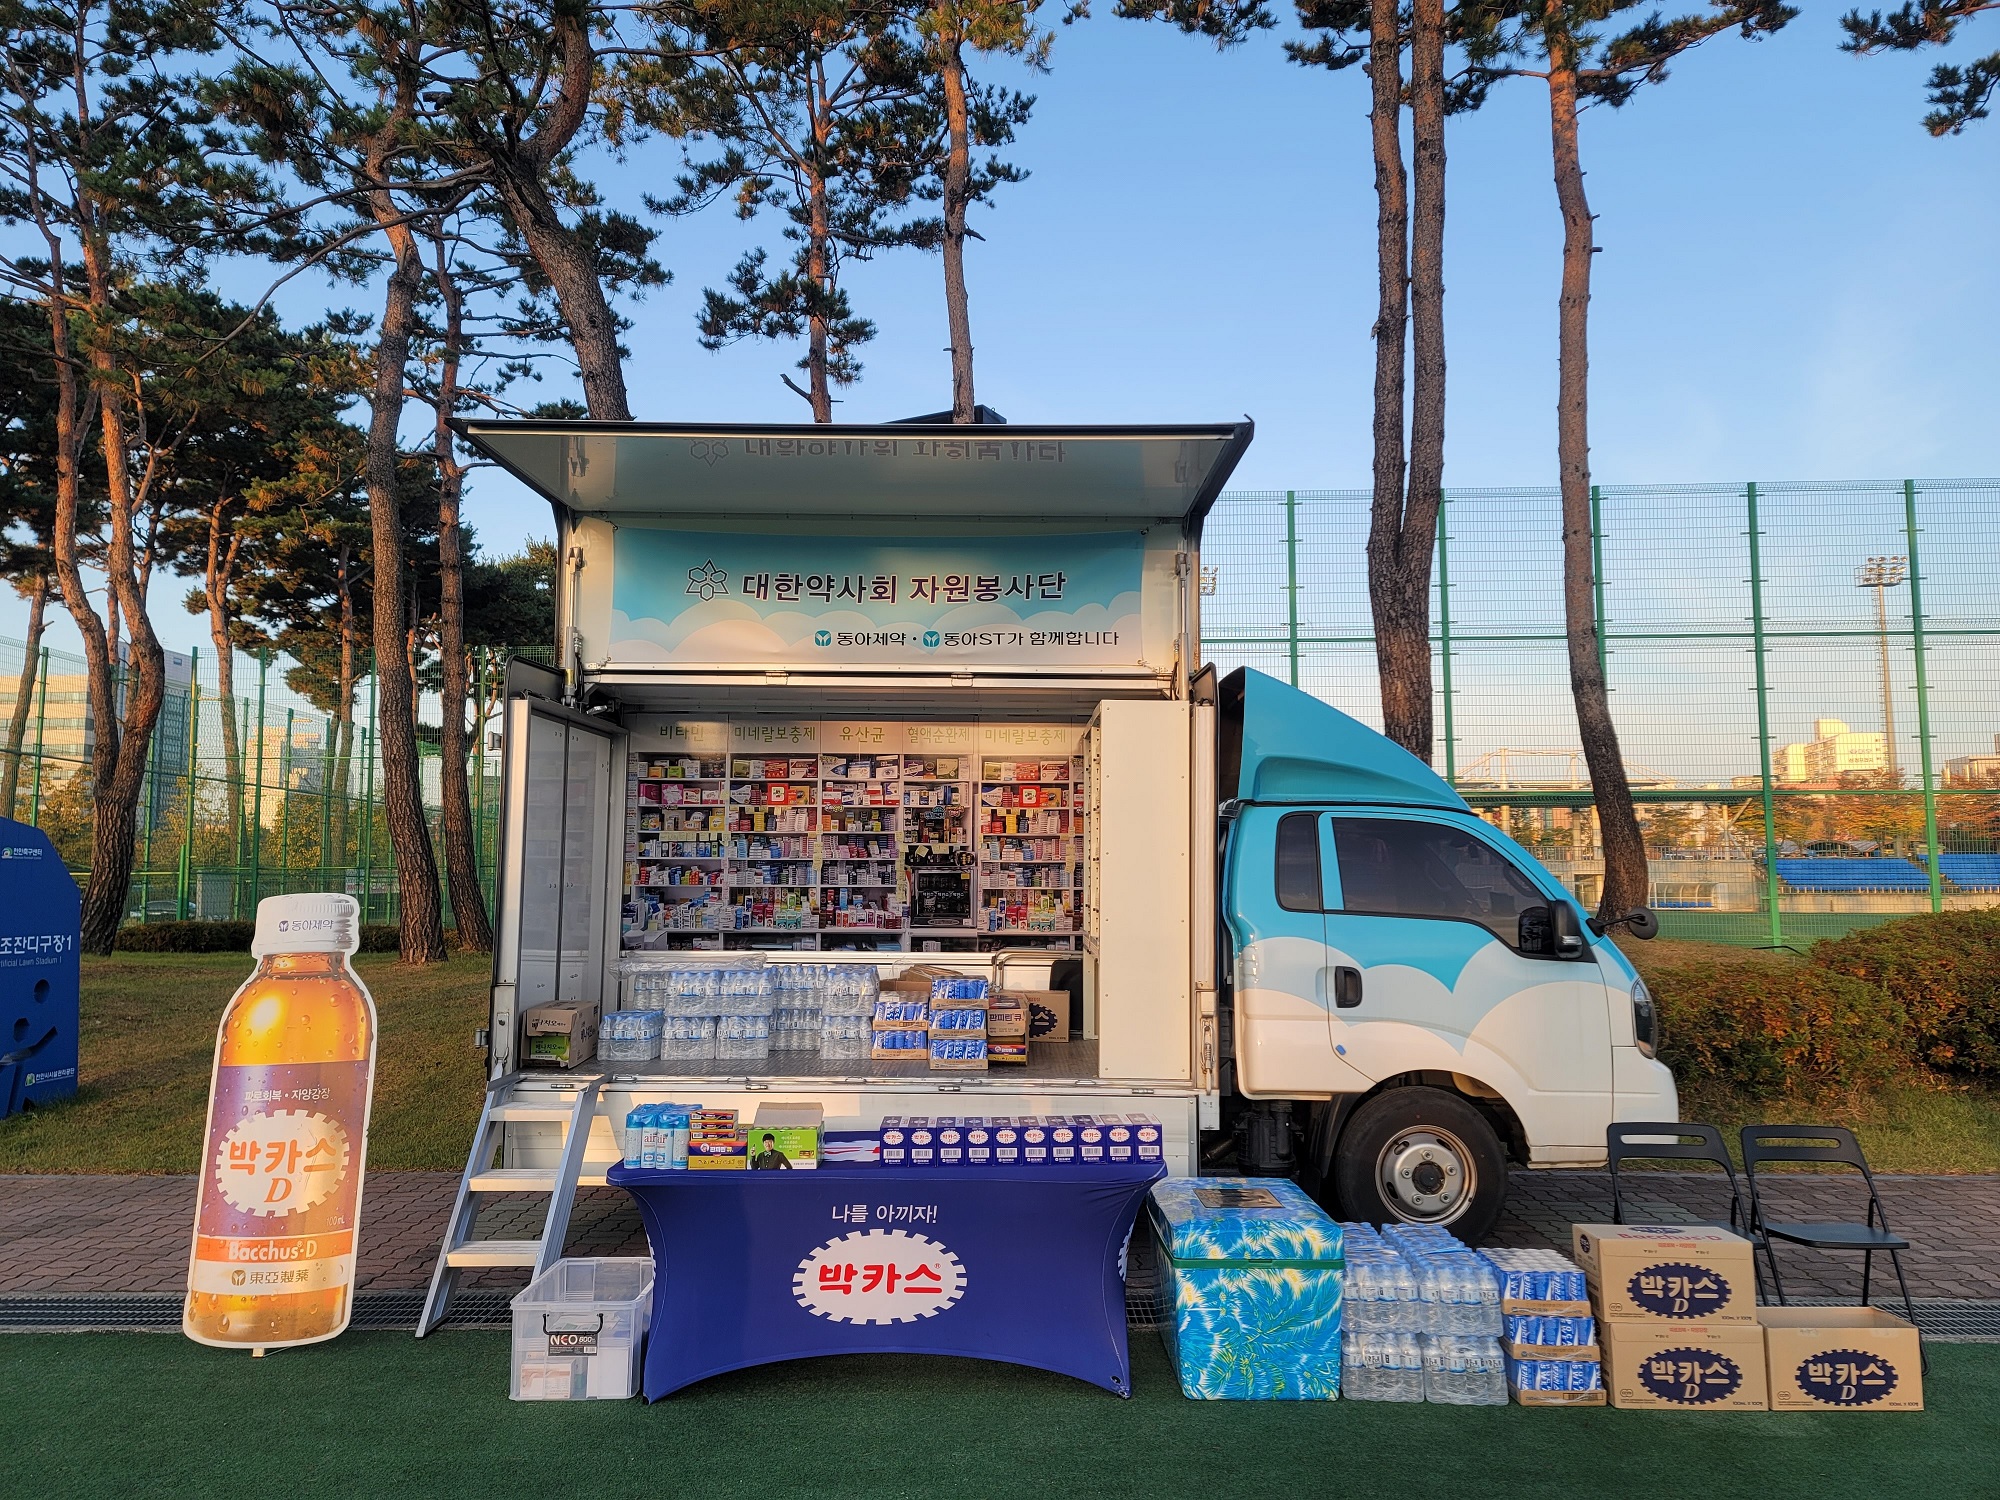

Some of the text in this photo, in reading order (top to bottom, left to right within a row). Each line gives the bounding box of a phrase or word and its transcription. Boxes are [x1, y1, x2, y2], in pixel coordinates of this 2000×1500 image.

[742, 571, 1066, 604] 대한약사회 자원봉사단
[837, 631, 1119, 646] 동아제약 동아ST가 함께합니다
[660, 725, 704, 742] 비타민
[734, 726, 816, 744] 미네랄보충제
[839, 726, 885, 743] 유산균
[907, 726, 970, 744] 혈액순환제
[985, 728, 1066, 745] 미네랄보충제
[291, 919, 335, 932] 동아제약
[0, 934, 72, 955] 조잔디구장1
[989, 1013, 1013, 1022] 판피린
[244, 1088, 331, 1101] 피로회복 자양강장
[229, 1136, 337, 1176] 박카스
[264, 1178, 293, 1203] D
[832, 1204, 938, 1224] 나를 아끼자!
[819, 1263, 943, 1295] 박카스
[1640, 1276, 1719, 1299] 박카스
[1673, 1299, 1689, 1313] D
[1651, 1361, 1730, 1384] 박카스
[1808, 1363, 1886, 1386] 박카스
[1683, 1384, 1700, 1399] D
[1840, 1386, 1856, 1400] D
